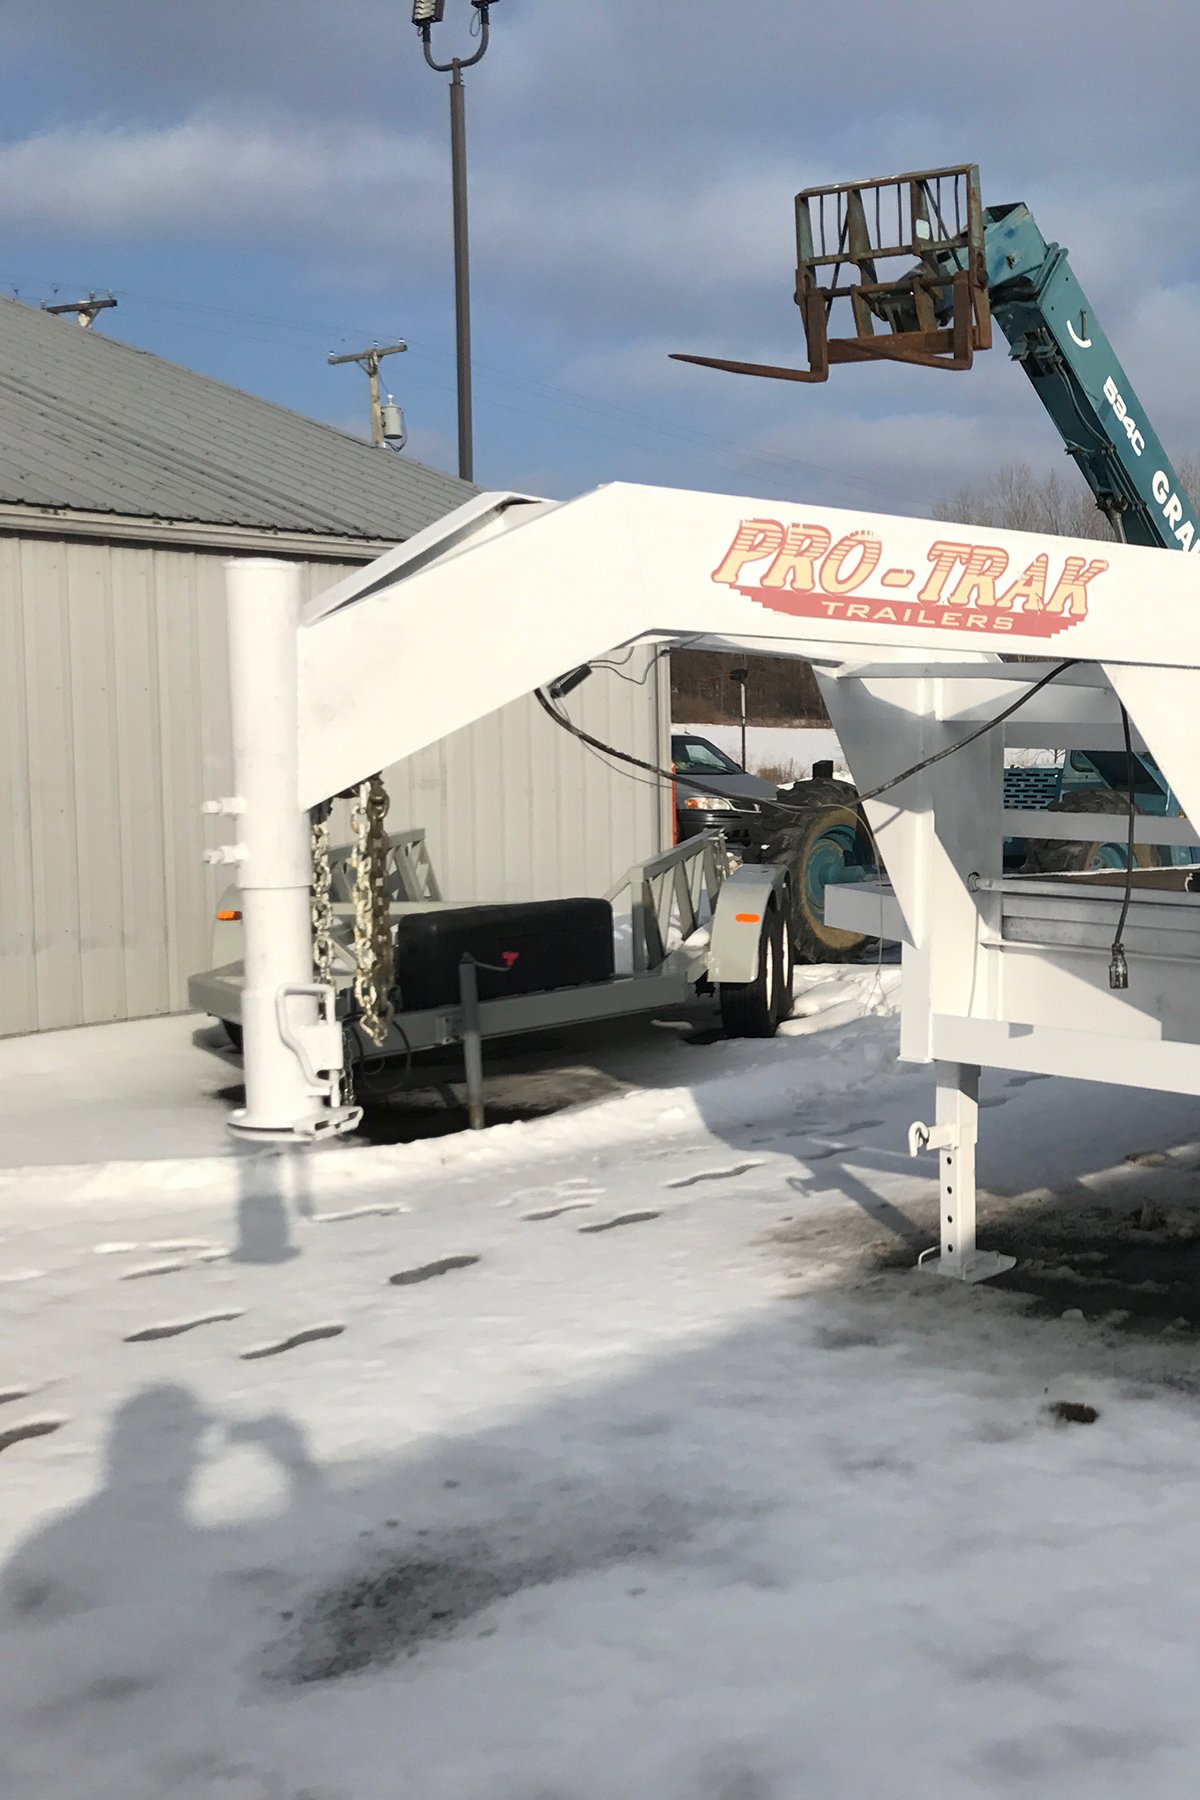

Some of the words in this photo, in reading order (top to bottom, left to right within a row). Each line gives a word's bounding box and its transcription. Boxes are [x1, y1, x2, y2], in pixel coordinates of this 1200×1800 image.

[1103, 376, 1145, 457] 534C
[711, 518, 1109, 617] PRO-TRAK
[821, 601, 1014, 631] TRAILERS
